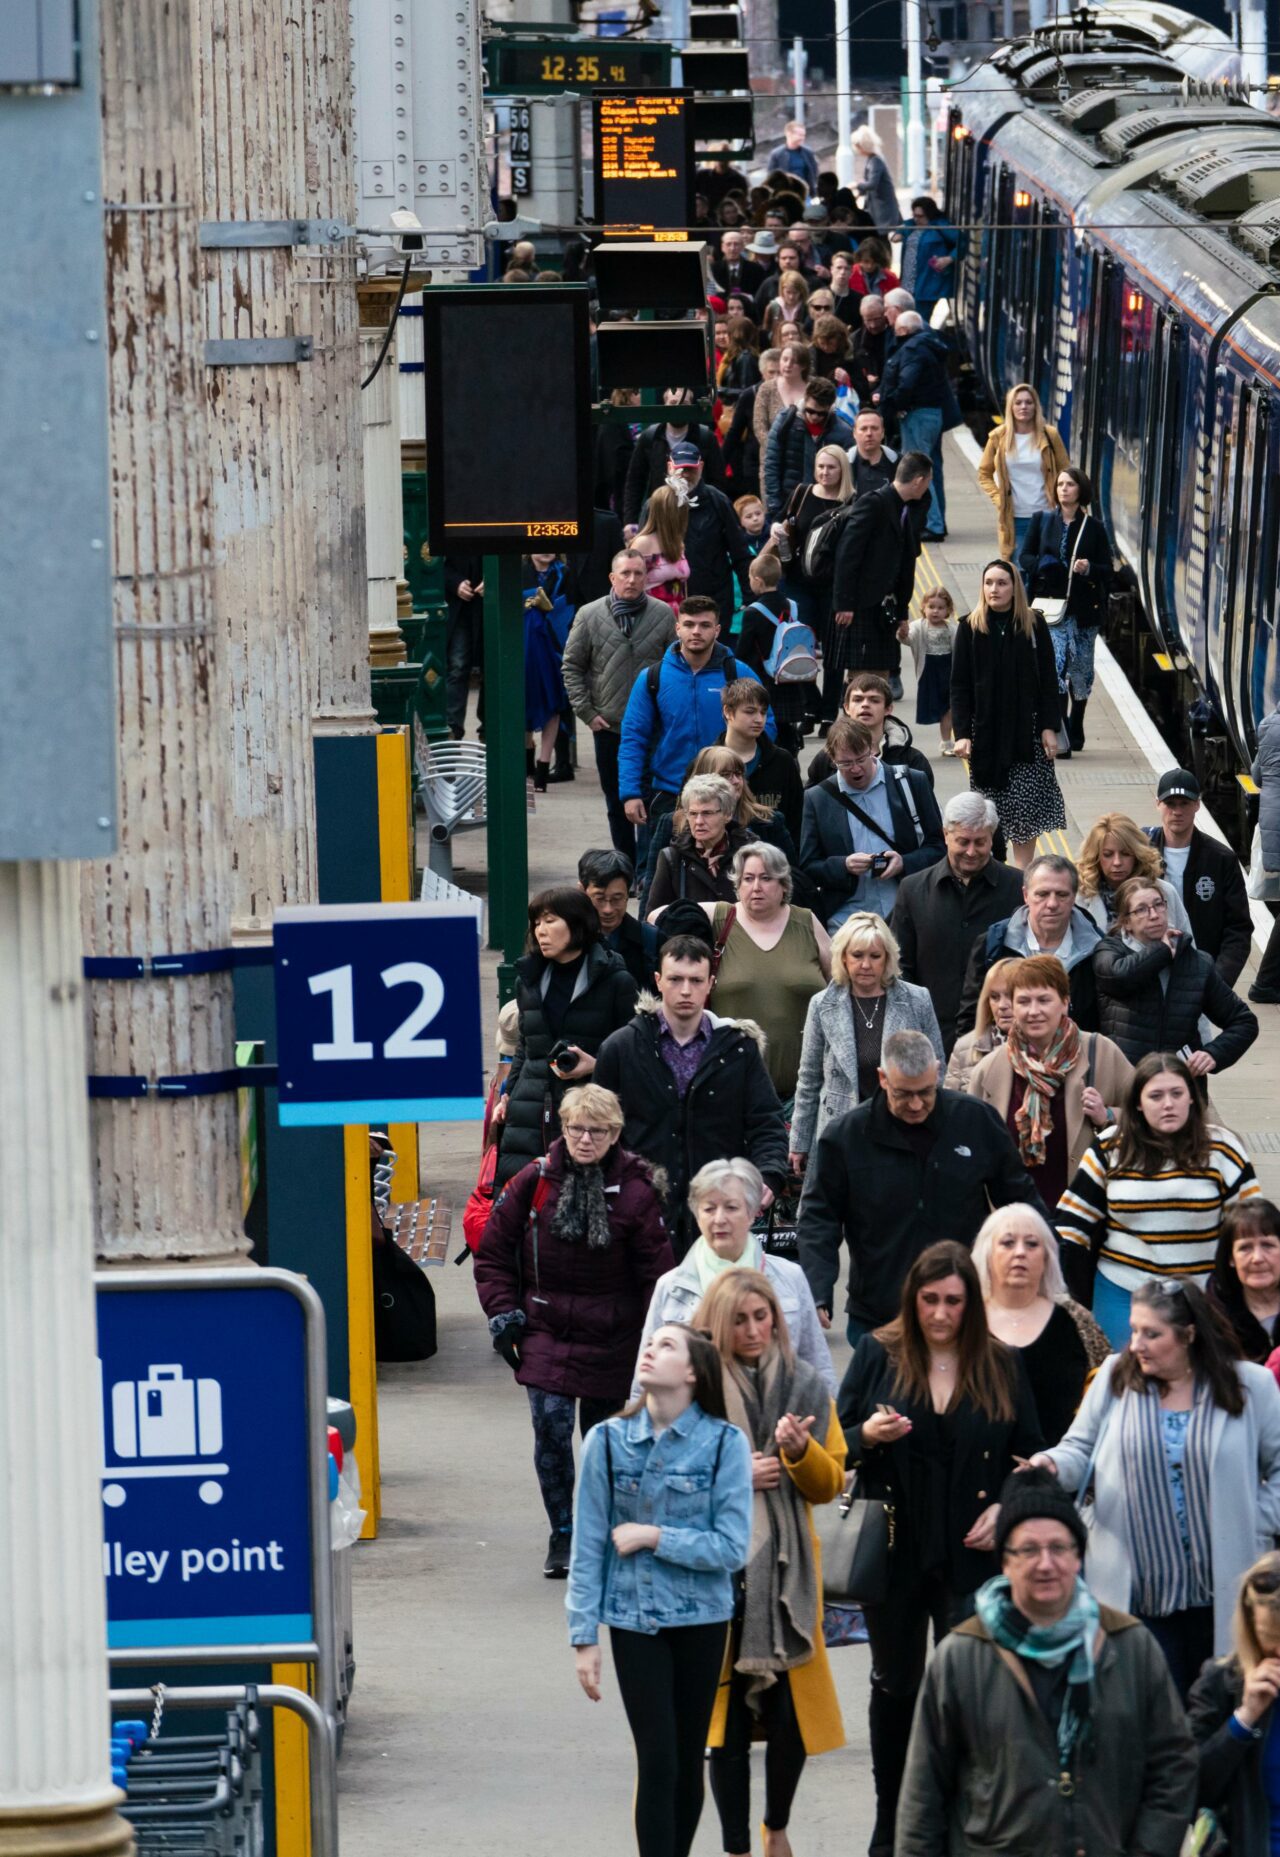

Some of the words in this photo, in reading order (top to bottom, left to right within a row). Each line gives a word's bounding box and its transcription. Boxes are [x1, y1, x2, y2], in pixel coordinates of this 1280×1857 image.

[527, 524, 579, 537] 12:35:26
[307, 961, 447, 1061] 12
[103, 1541, 170, 1584] lley
[181, 1538, 285, 1582] point
